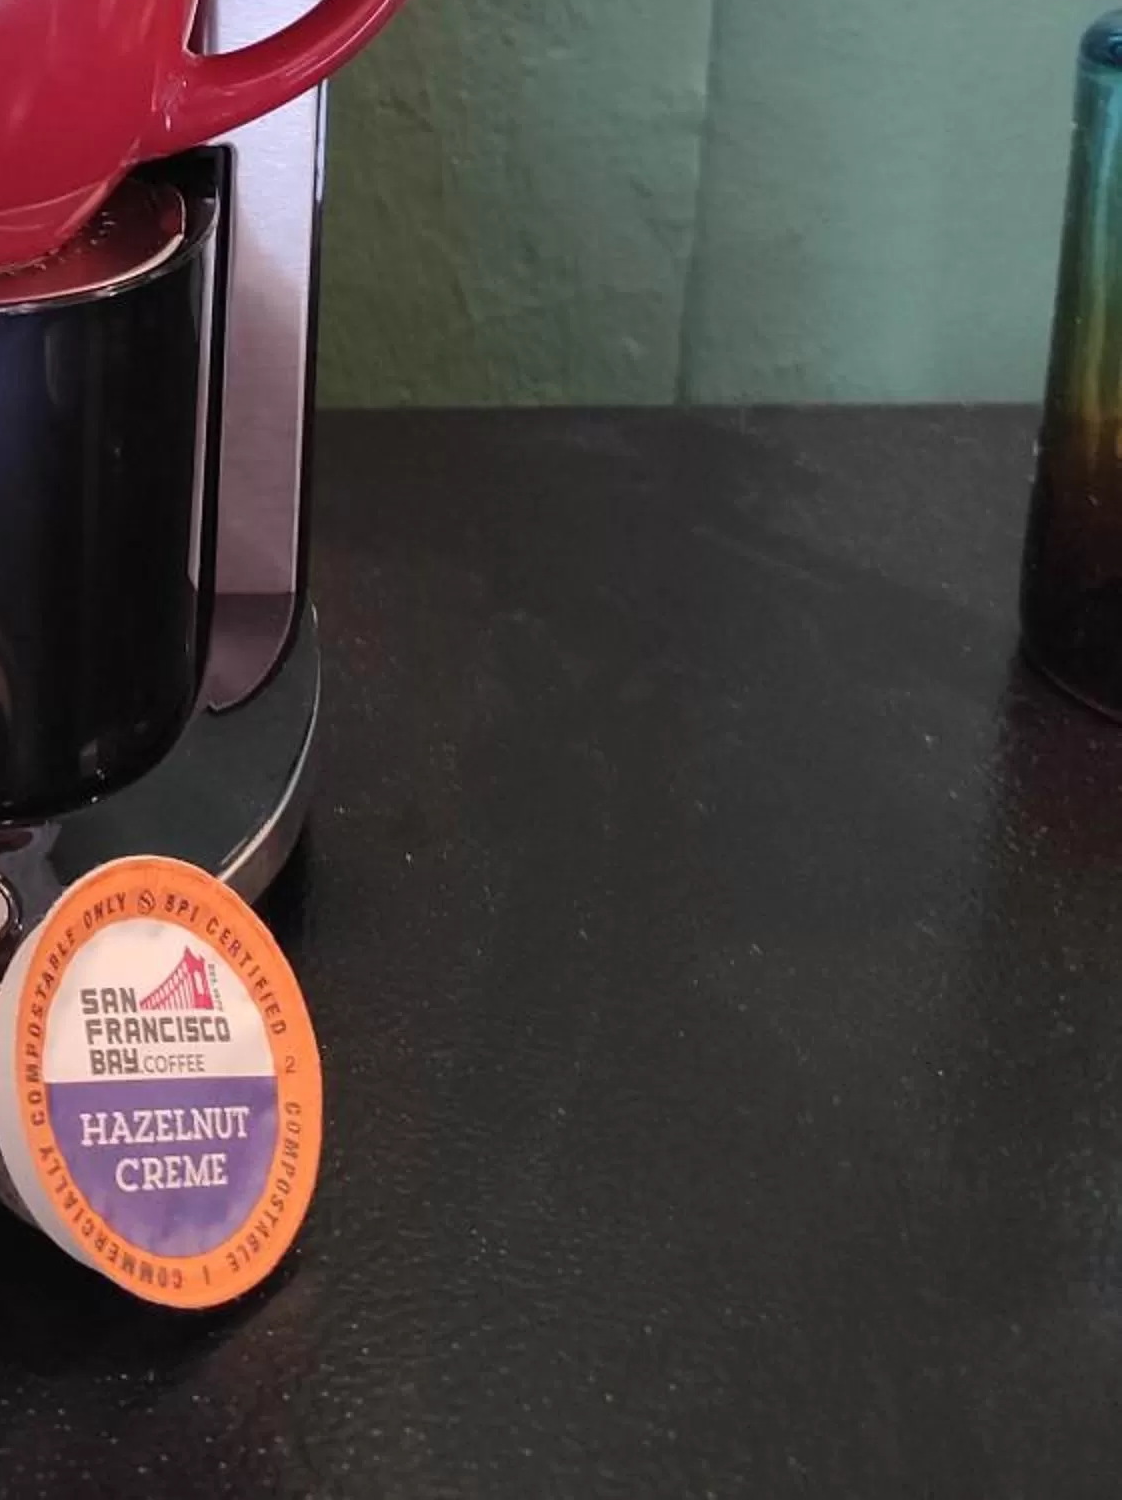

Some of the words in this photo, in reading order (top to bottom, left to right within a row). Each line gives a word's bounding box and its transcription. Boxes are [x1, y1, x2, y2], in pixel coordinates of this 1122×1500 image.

[83, 892, 128, 929] ONLY
[164, 893, 200, 924] BPI
[206, 916, 287, 1036] CERTIFIED
[80, 987, 138, 1015] SAN
[27, 928, 77, 1127] COMPOSTABLE
[86, 1016, 232, 1045] FRANCISCO
[79, 1106, 251, 1147] HAZELNUT
[115, 1153, 229, 1192] CREME
[228, 1102, 303, 1274] COMPOSTABLE
[40, 1145, 184, 1290] COMMERCIALLY
